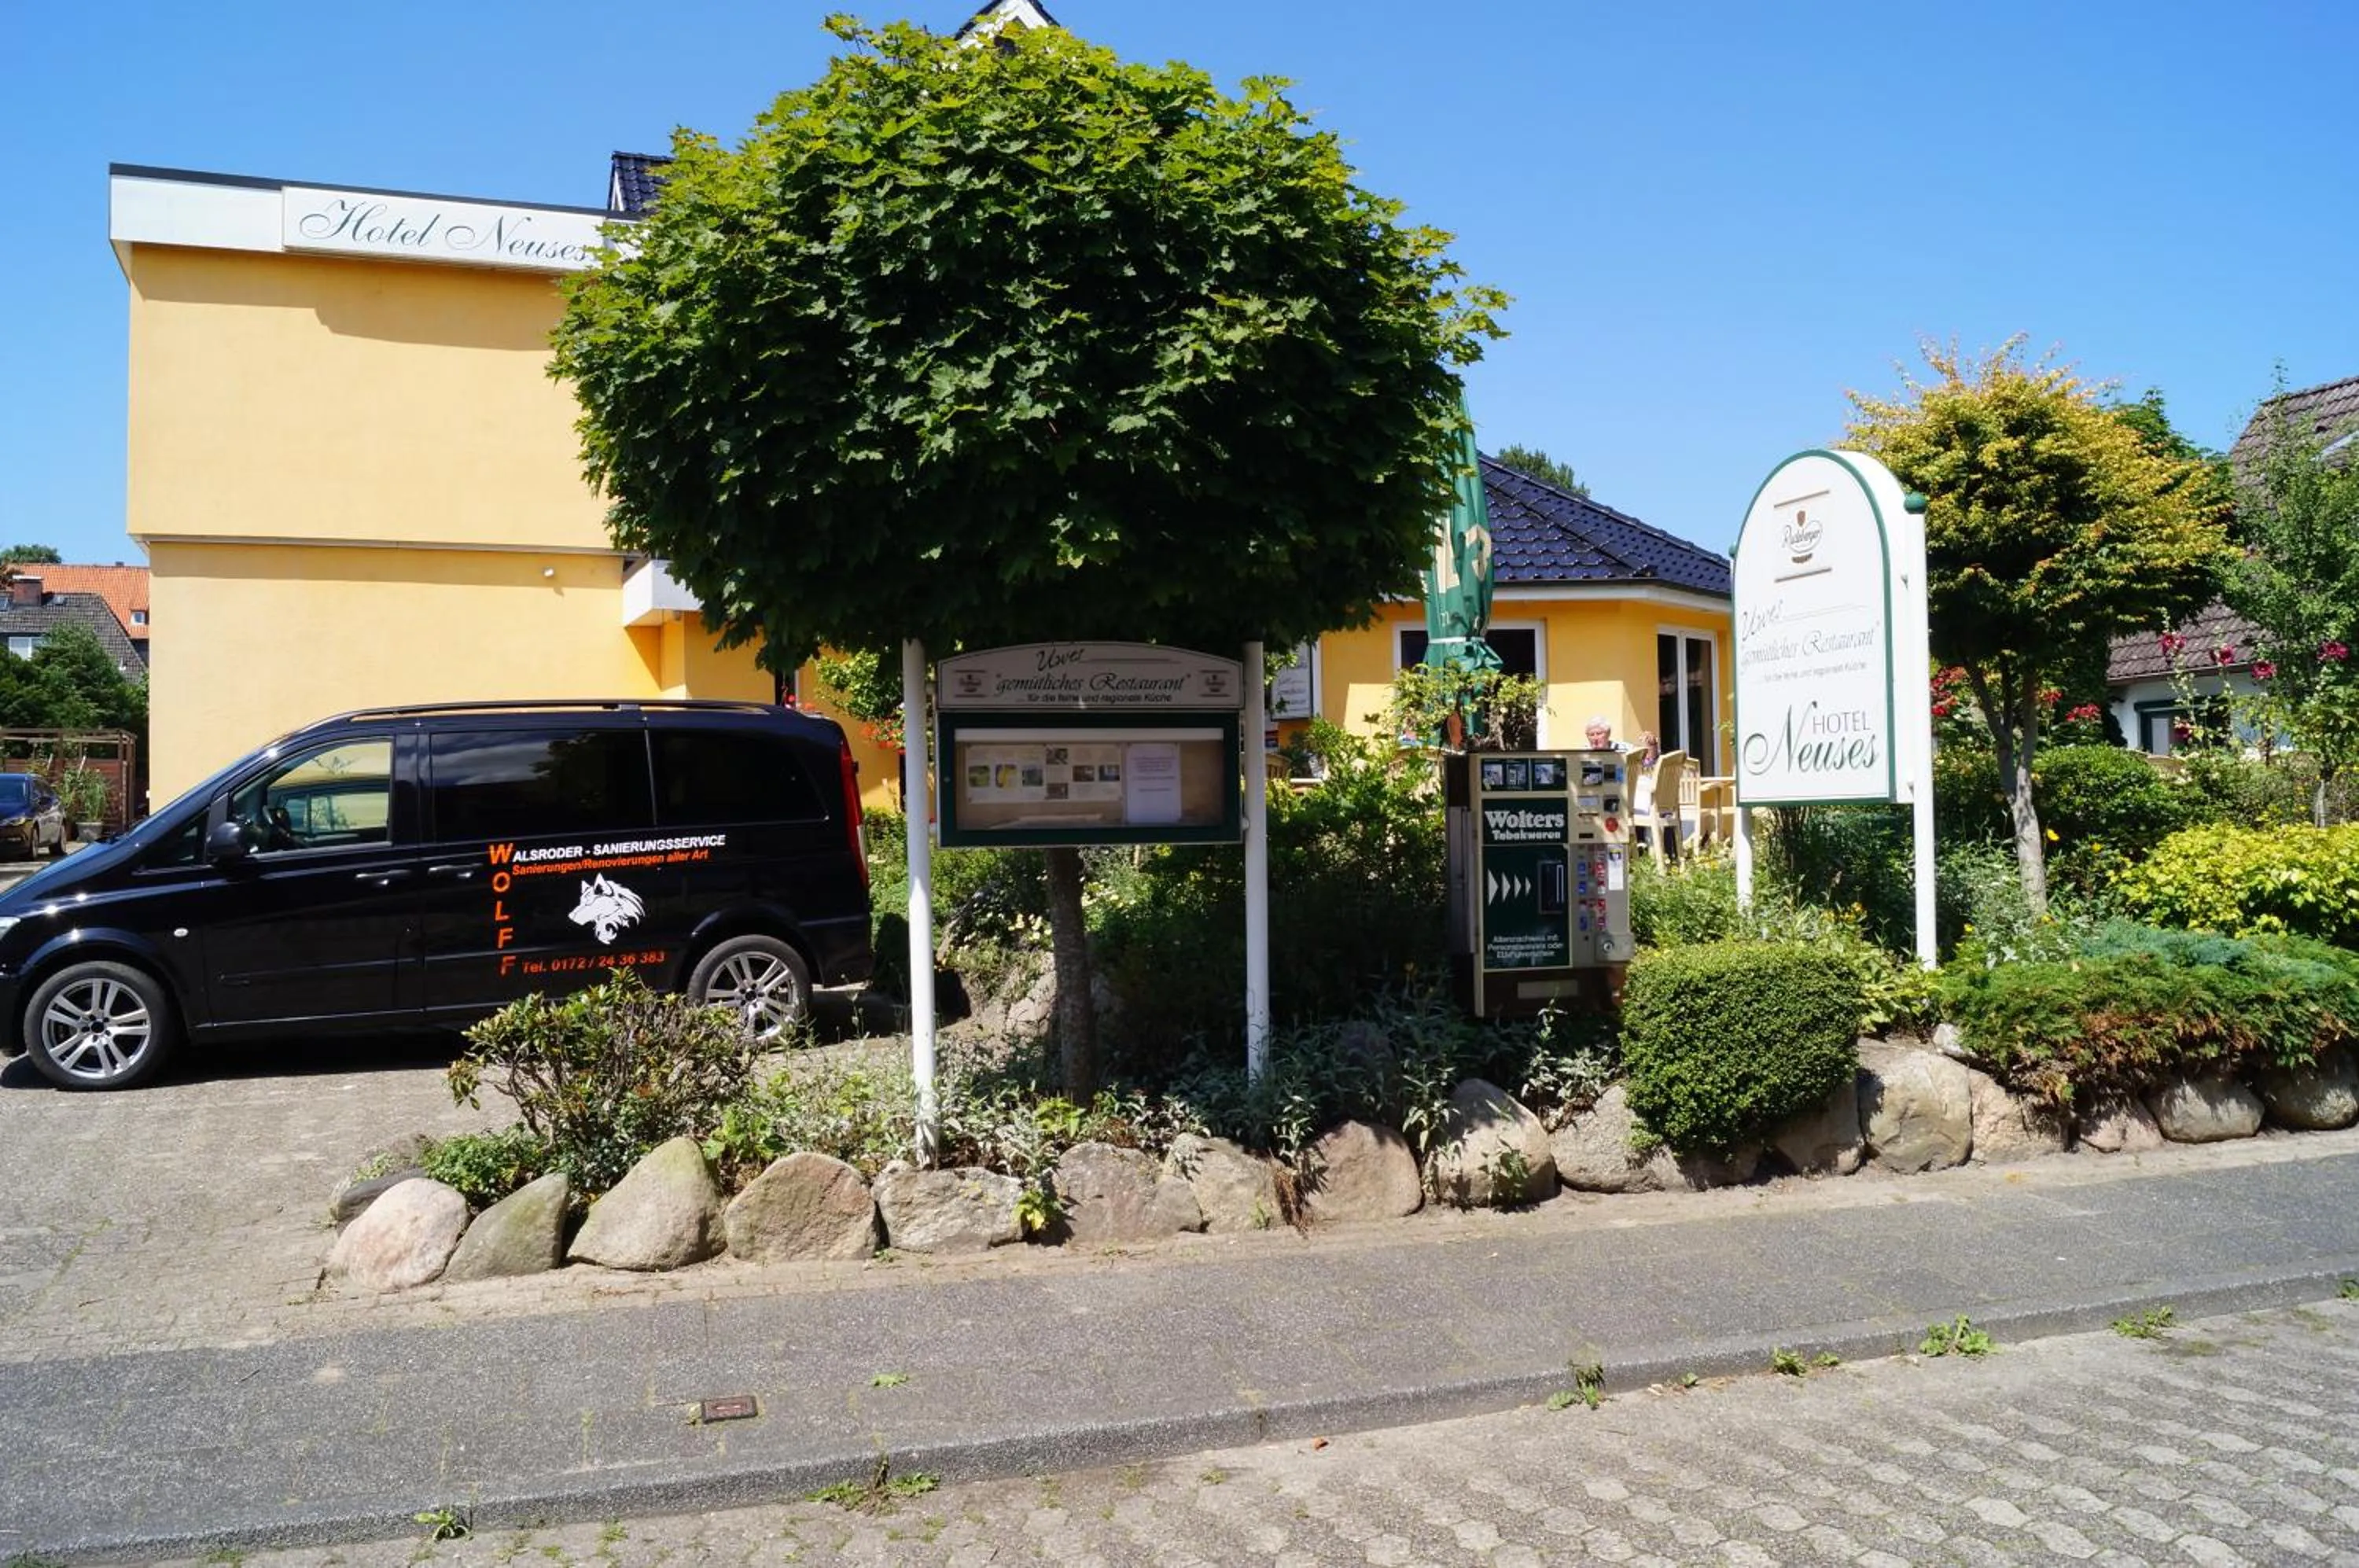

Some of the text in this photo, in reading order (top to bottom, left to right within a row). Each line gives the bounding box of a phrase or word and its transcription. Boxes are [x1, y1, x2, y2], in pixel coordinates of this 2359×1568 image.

[299, 199, 589, 263] Hotel Neuses
[1812, 709, 1871, 735] HOTEL
[1743, 700, 1880, 776] Neuses
[1485, 810, 1565, 829] Wolters
[592, 834, 727, 856] SANIERUNGSSERVICE
[1492, 830, 1562, 841] Tabakwaren
[666, 852, 690, 863] aller
[691, 849, 710, 861] Art
[522, 961, 547, 974] Tel.
[551, 956, 587, 971] 0172
[598, 955, 616, 968] 24
[618, 954, 636, 966] 36
[639, 951, 666, 964] 383
